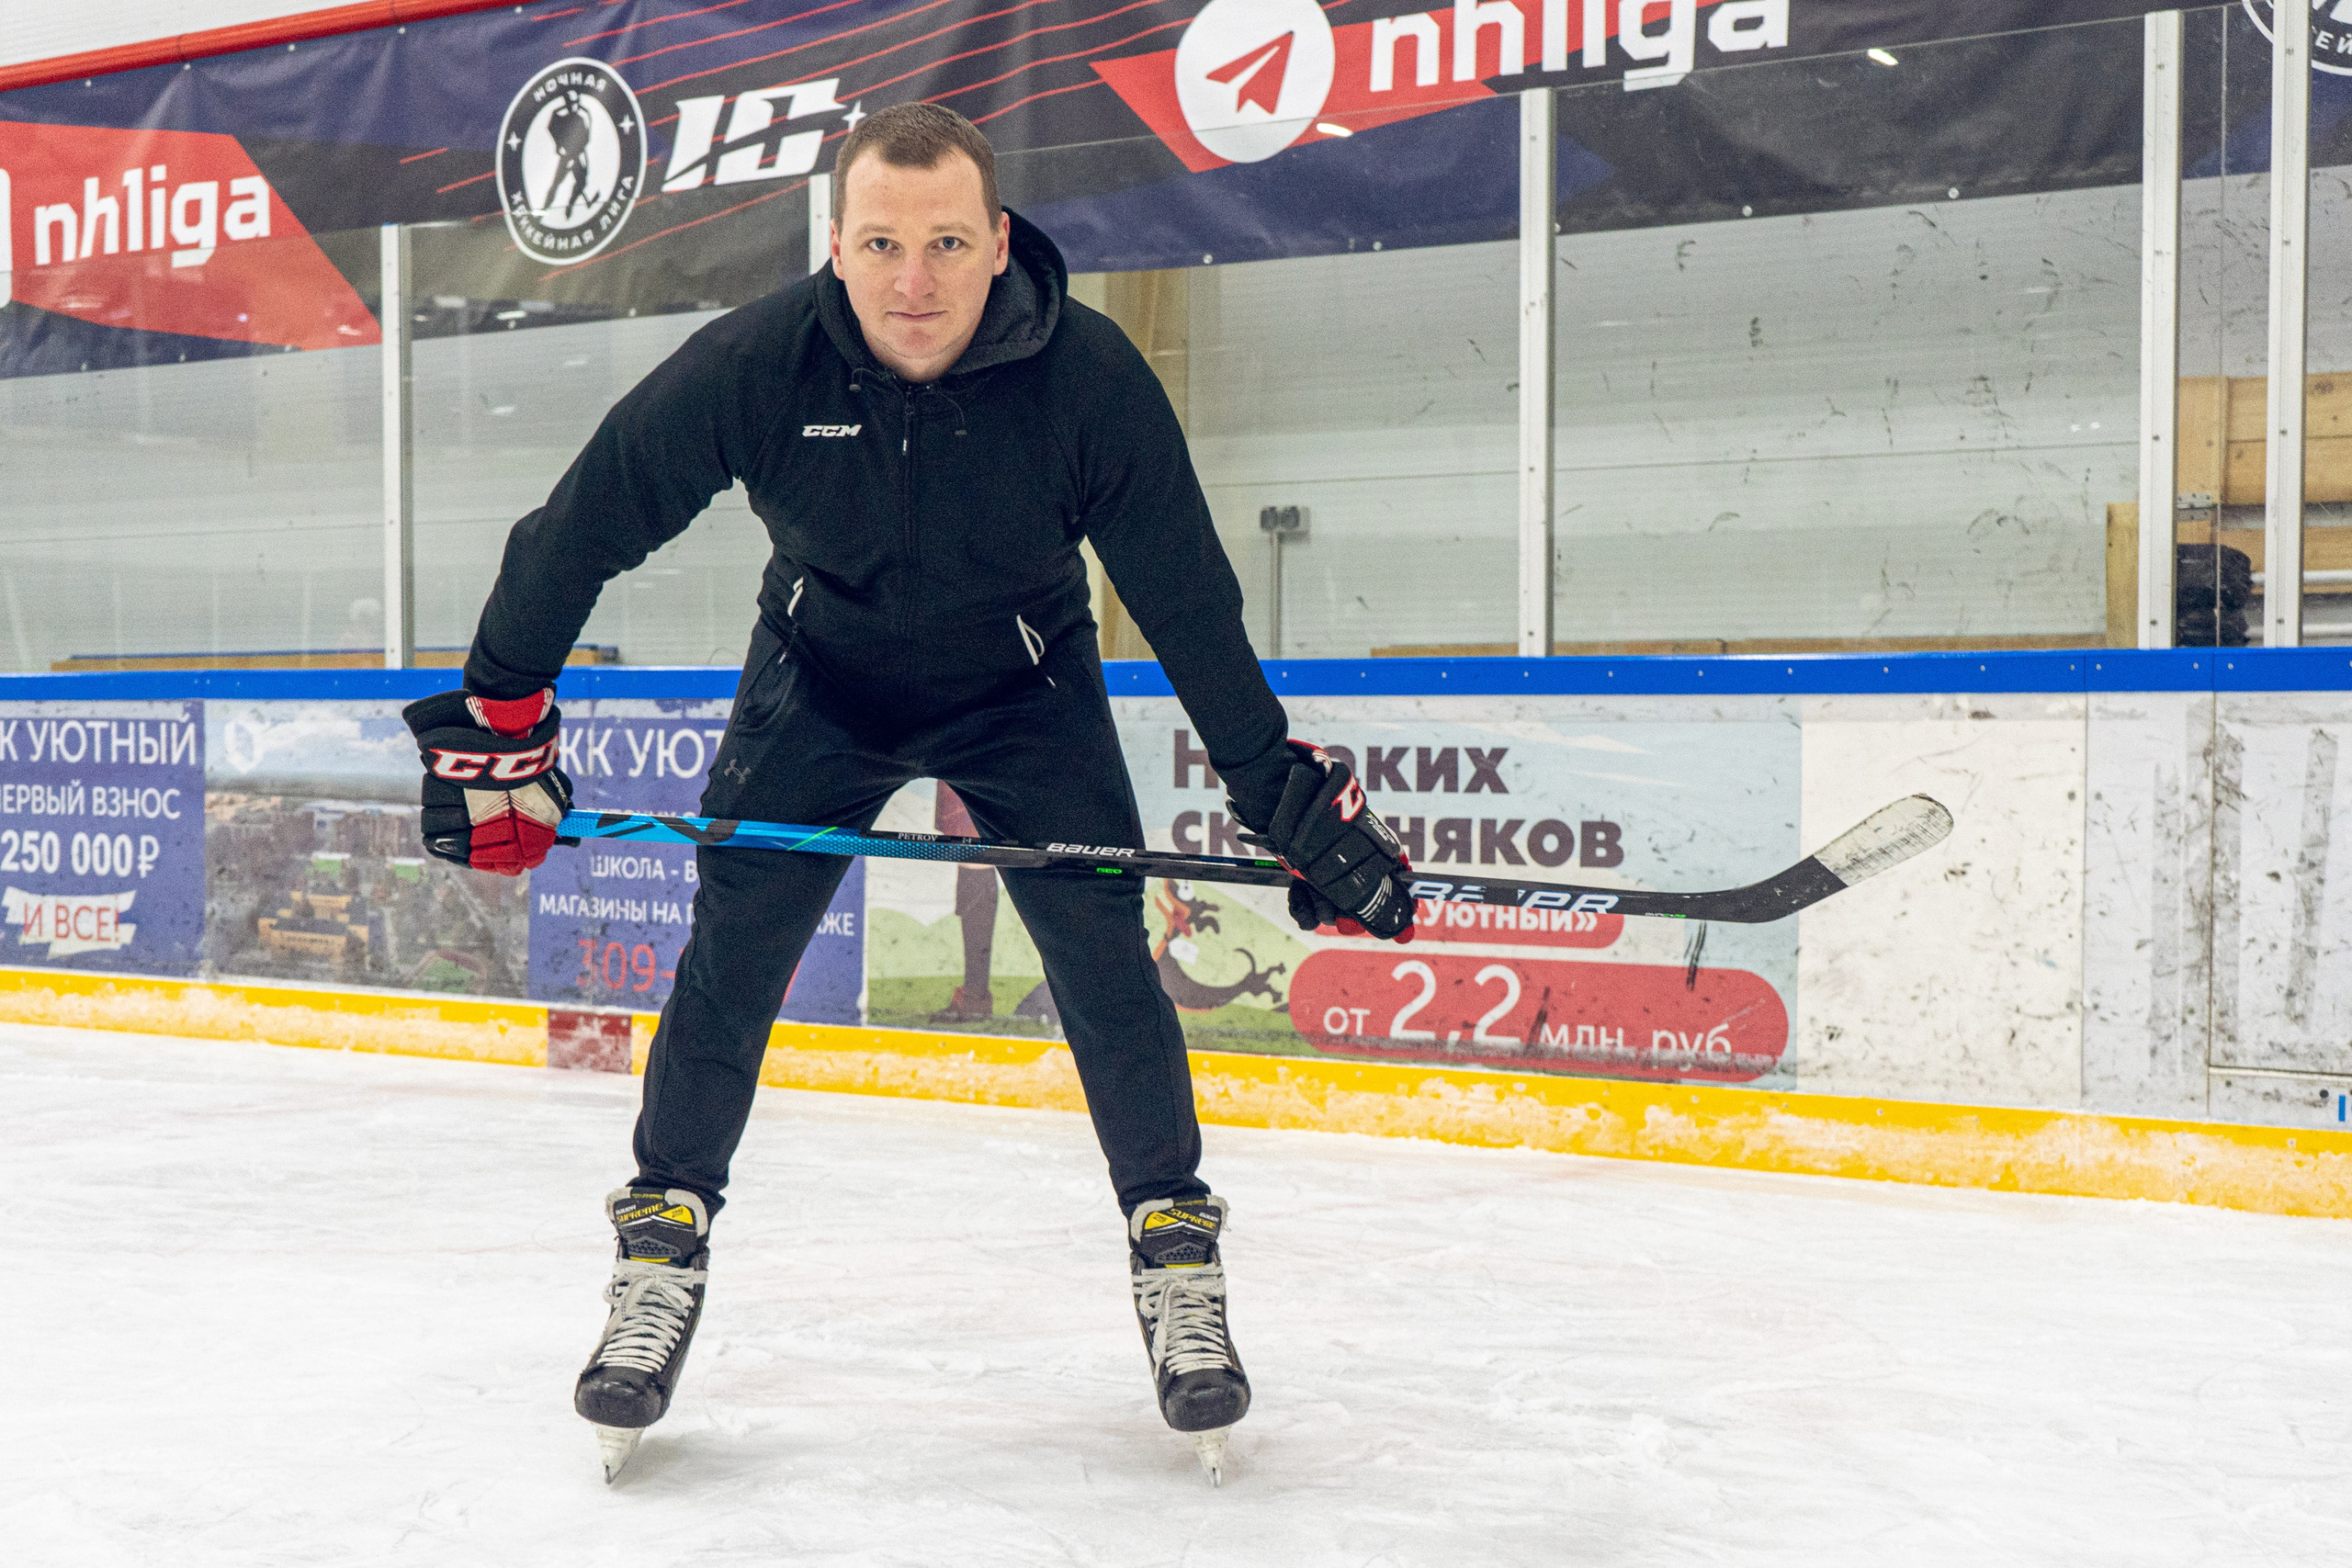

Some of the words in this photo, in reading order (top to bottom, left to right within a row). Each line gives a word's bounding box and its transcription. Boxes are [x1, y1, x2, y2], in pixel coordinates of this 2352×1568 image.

[532, 72, 608, 102] НОЧНАЯ
[599, 175, 634, 231] ЛИГА
[802, 423, 863, 437] CCM
[26, 712, 197, 766] УЮТНЫЙ
[624, 728, 726, 779] УЮТ
[92, 785, 182, 820] ВЗНОС
[0, 829, 61, 874] 250
[897, 832, 938, 842] PETROV
[589, 854, 666, 881] ШКОЛА
[24, 901, 43, 939] И
[54, 903, 120, 943] ВСЕ!
[539, 893, 647, 921] МАГАЗИНЫ
[651, 900, 683, 924] НА
[1323, 1006, 1371, 1037] от
[1388, 959, 1521, 1055] 2,2
